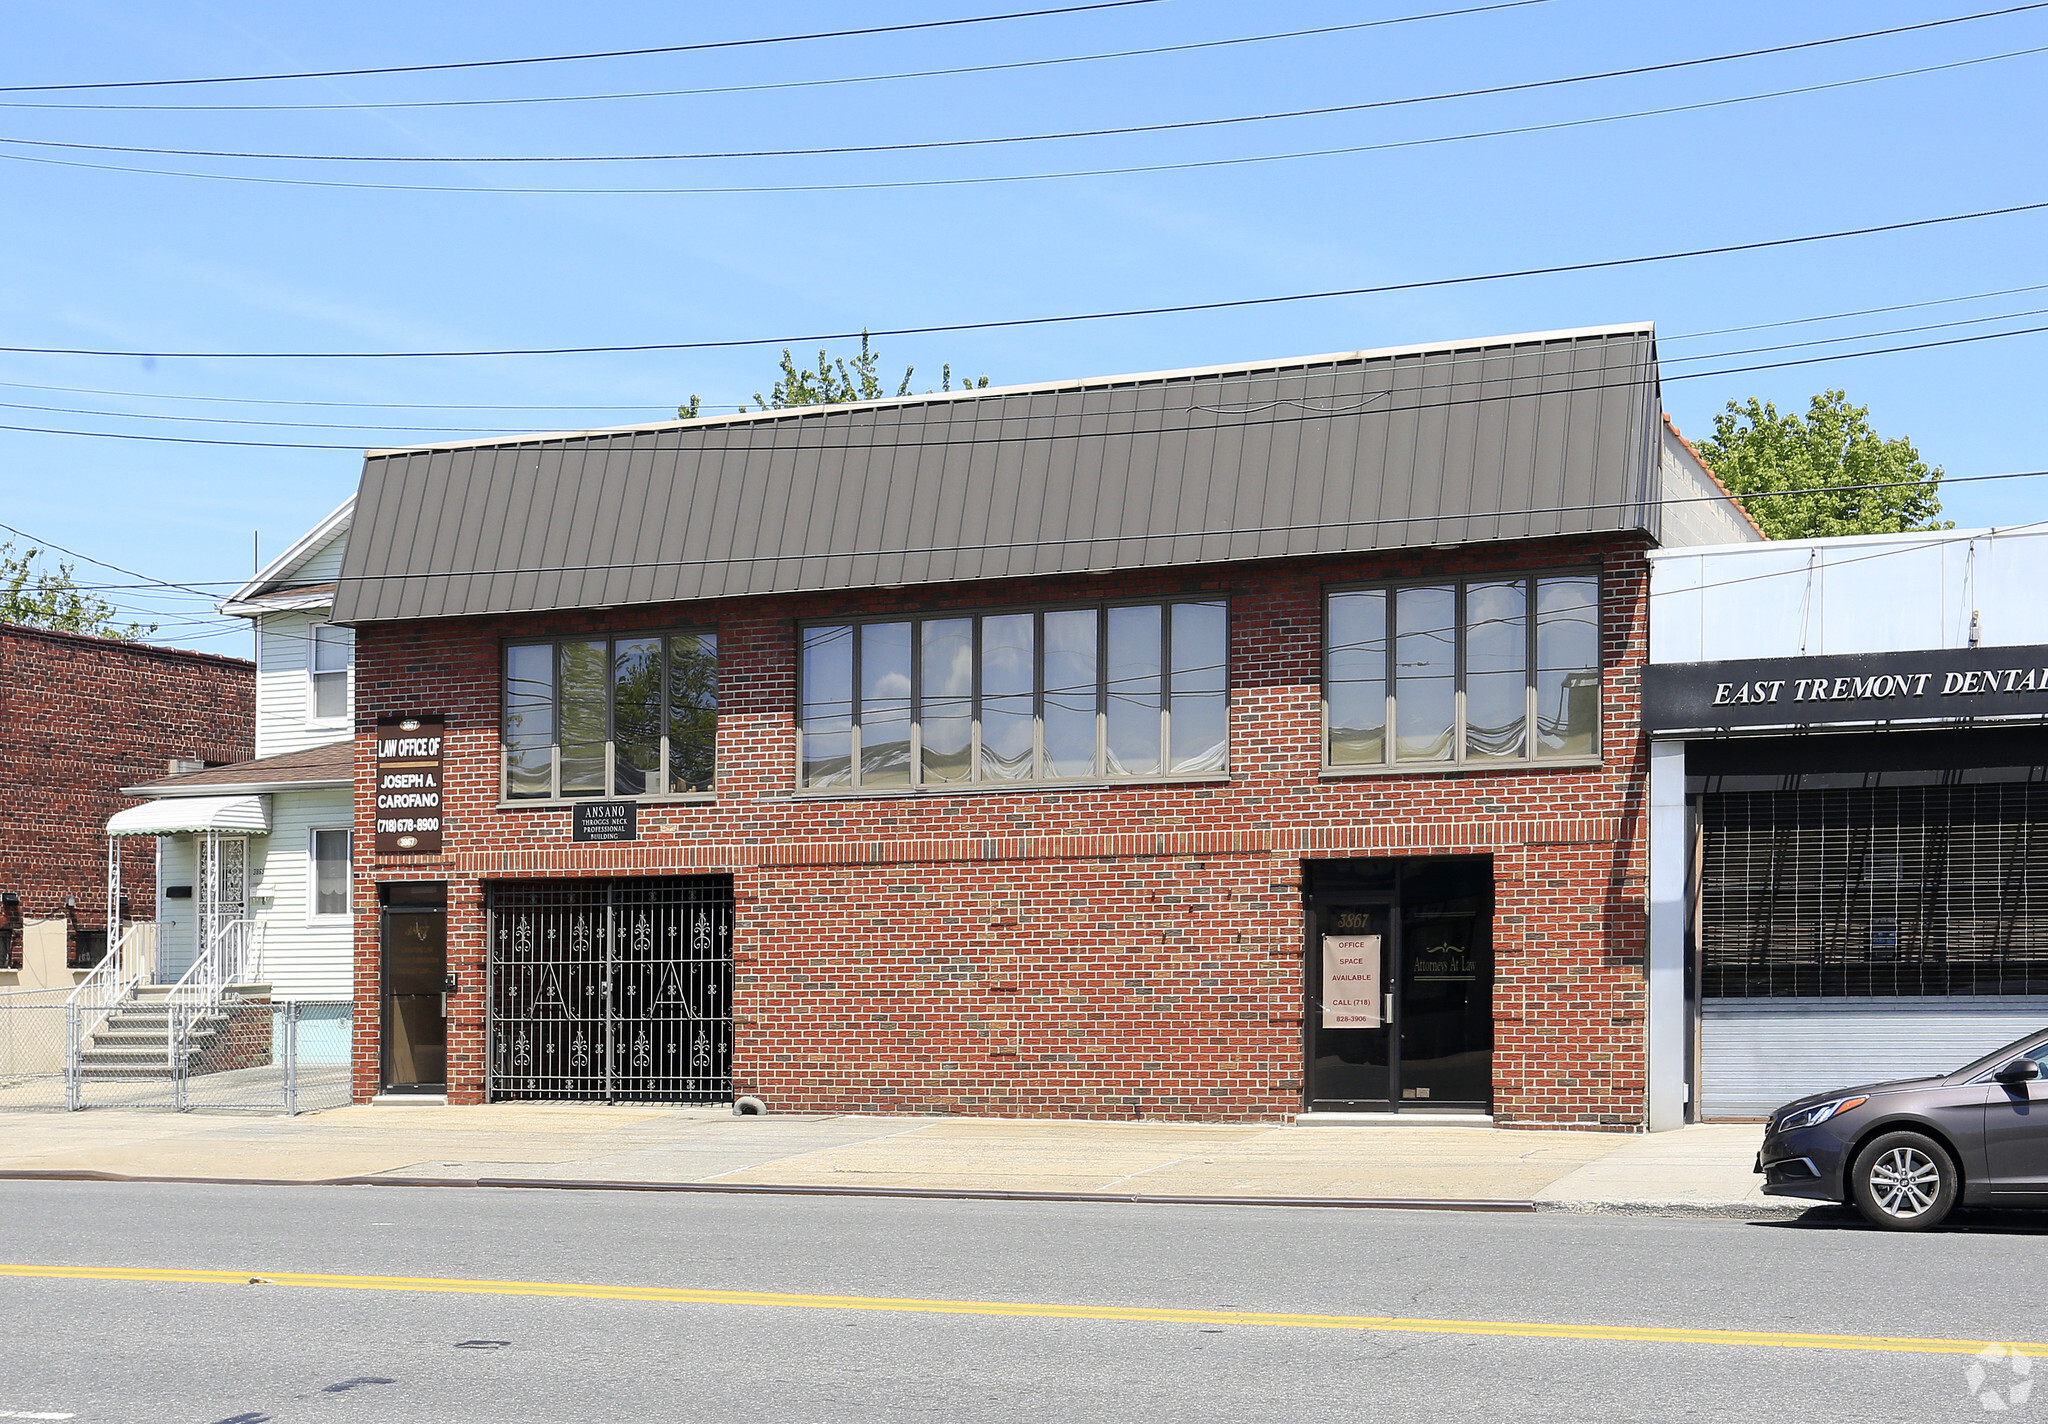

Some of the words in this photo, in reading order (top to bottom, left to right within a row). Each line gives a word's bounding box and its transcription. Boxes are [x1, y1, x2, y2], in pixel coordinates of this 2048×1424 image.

[1712, 680, 1785, 705] EAST
[1793, 673, 1932, 701] TREMONT
[378, 739, 398, 758] LAW
[398, 738, 428, 757] OFFICE
[428, 737, 441, 756] OF
[380, 773, 424, 789] JOSEPH
[425, 773, 437, 787] A.
[377, 793, 439, 809] CAROFANO
[585, 805, 625, 818] ANSANO
[377, 818, 396, 834] (718)
[397, 818, 439, 832] 678-8900
[1337, 913, 1369, 928] 3867
[1338, 941, 1365, 949] OFFICE
